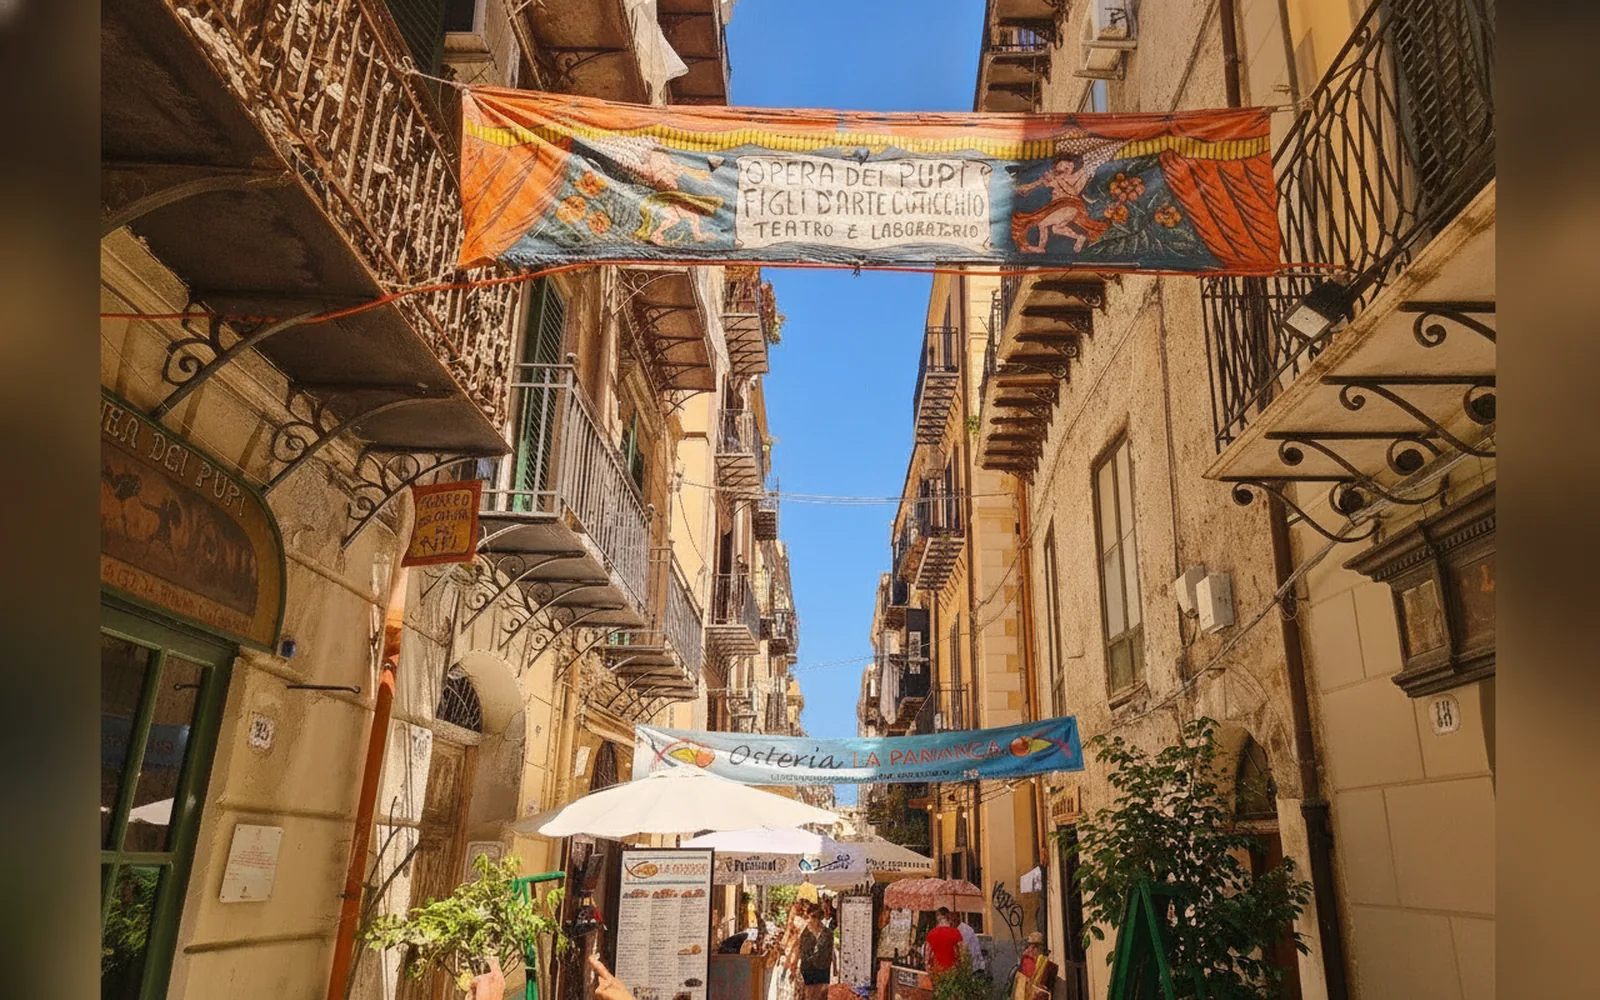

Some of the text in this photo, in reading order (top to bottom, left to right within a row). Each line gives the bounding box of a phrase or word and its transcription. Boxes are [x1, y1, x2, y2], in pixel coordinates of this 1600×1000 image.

[746, 160, 969, 188] OPERA DEI PUPI
[743, 188, 807, 217] FIGLI
[753, 220, 834, 238] TEATRO
[871, 221, 979, 240] LABORATORIO
[729, 744, 844, 769] Osteria
[853, 751, 881, 768] LA
